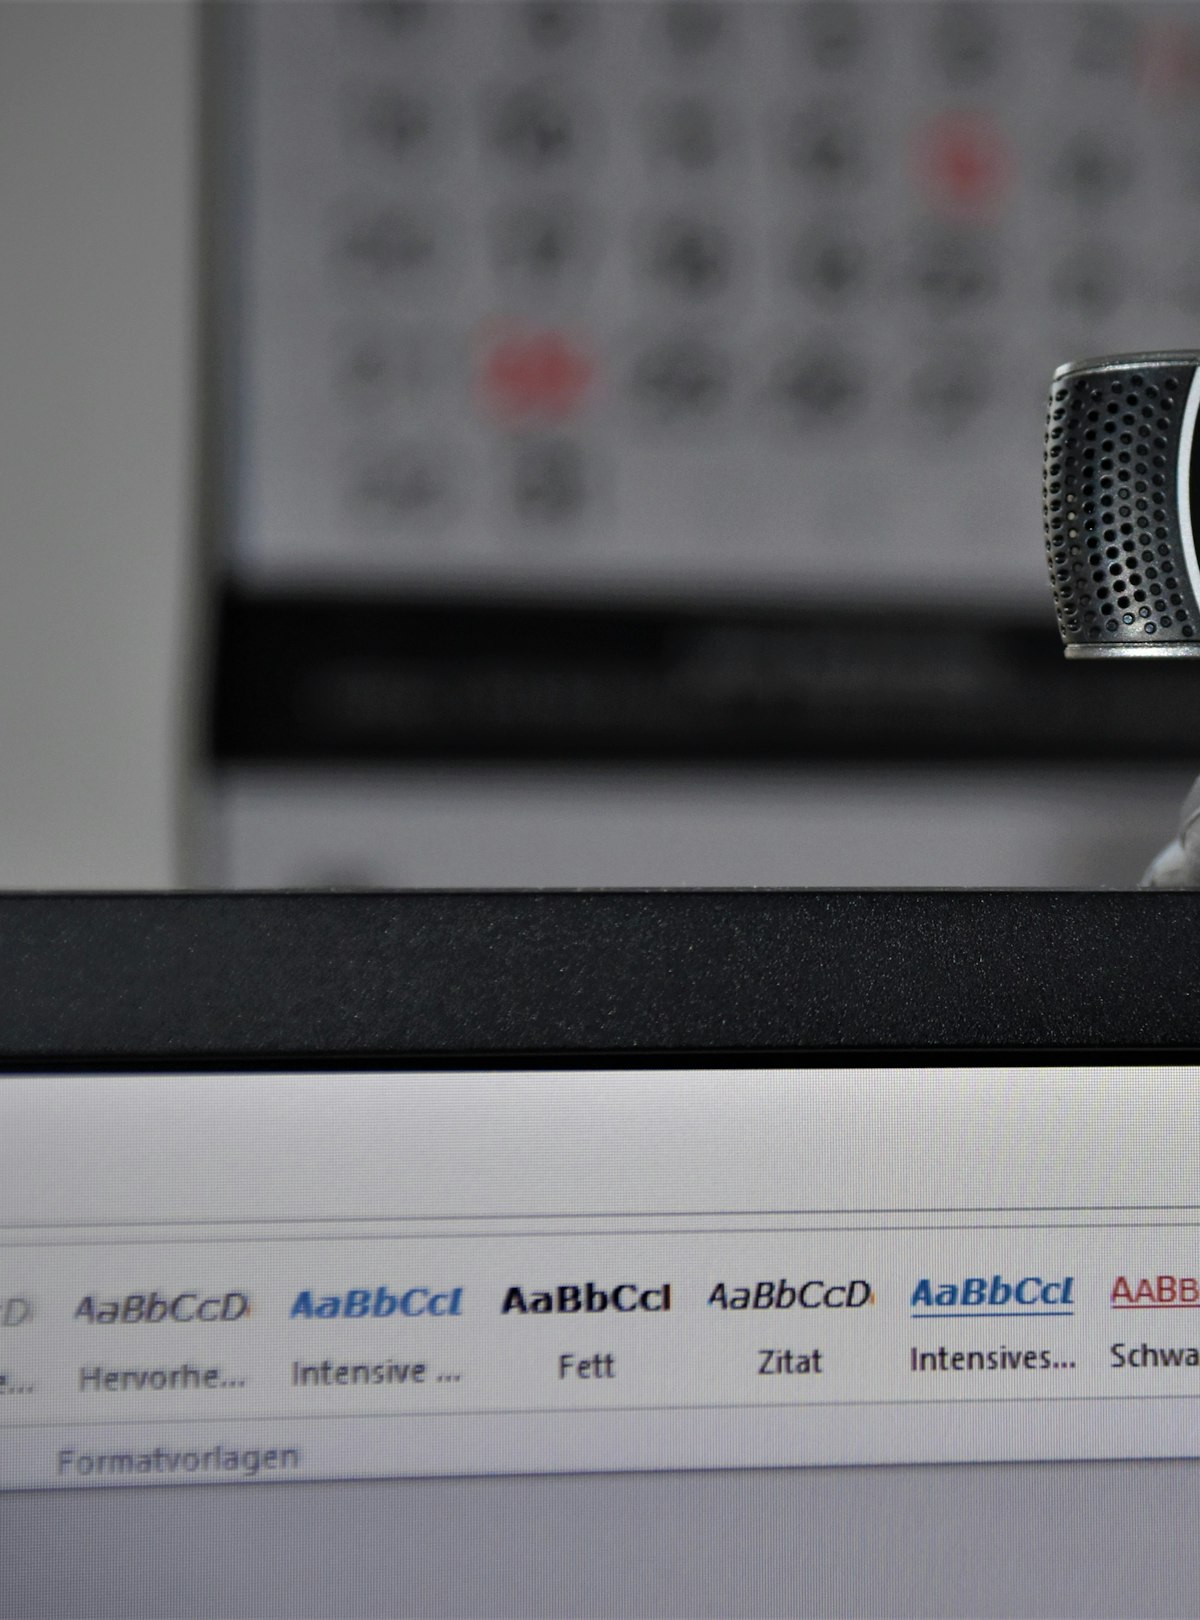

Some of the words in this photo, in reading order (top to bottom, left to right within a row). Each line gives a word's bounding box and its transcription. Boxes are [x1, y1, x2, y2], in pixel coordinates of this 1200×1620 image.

[74, 1291, 249, 1325] AaBbCcD
[706, 1279, 873, 1310] AaBbCcD
[558, 1352, 616, 1380] Fett
[757, 1348, 823, 1375] Zitat
[910, 1345, 1077, 1371] Intensives...
[79, 1364, 246, 1393] Hervorhe...
[291, 1359, 426, 1387] Intensive
[58, 1446, 299, 1478] Formatvorlagen
